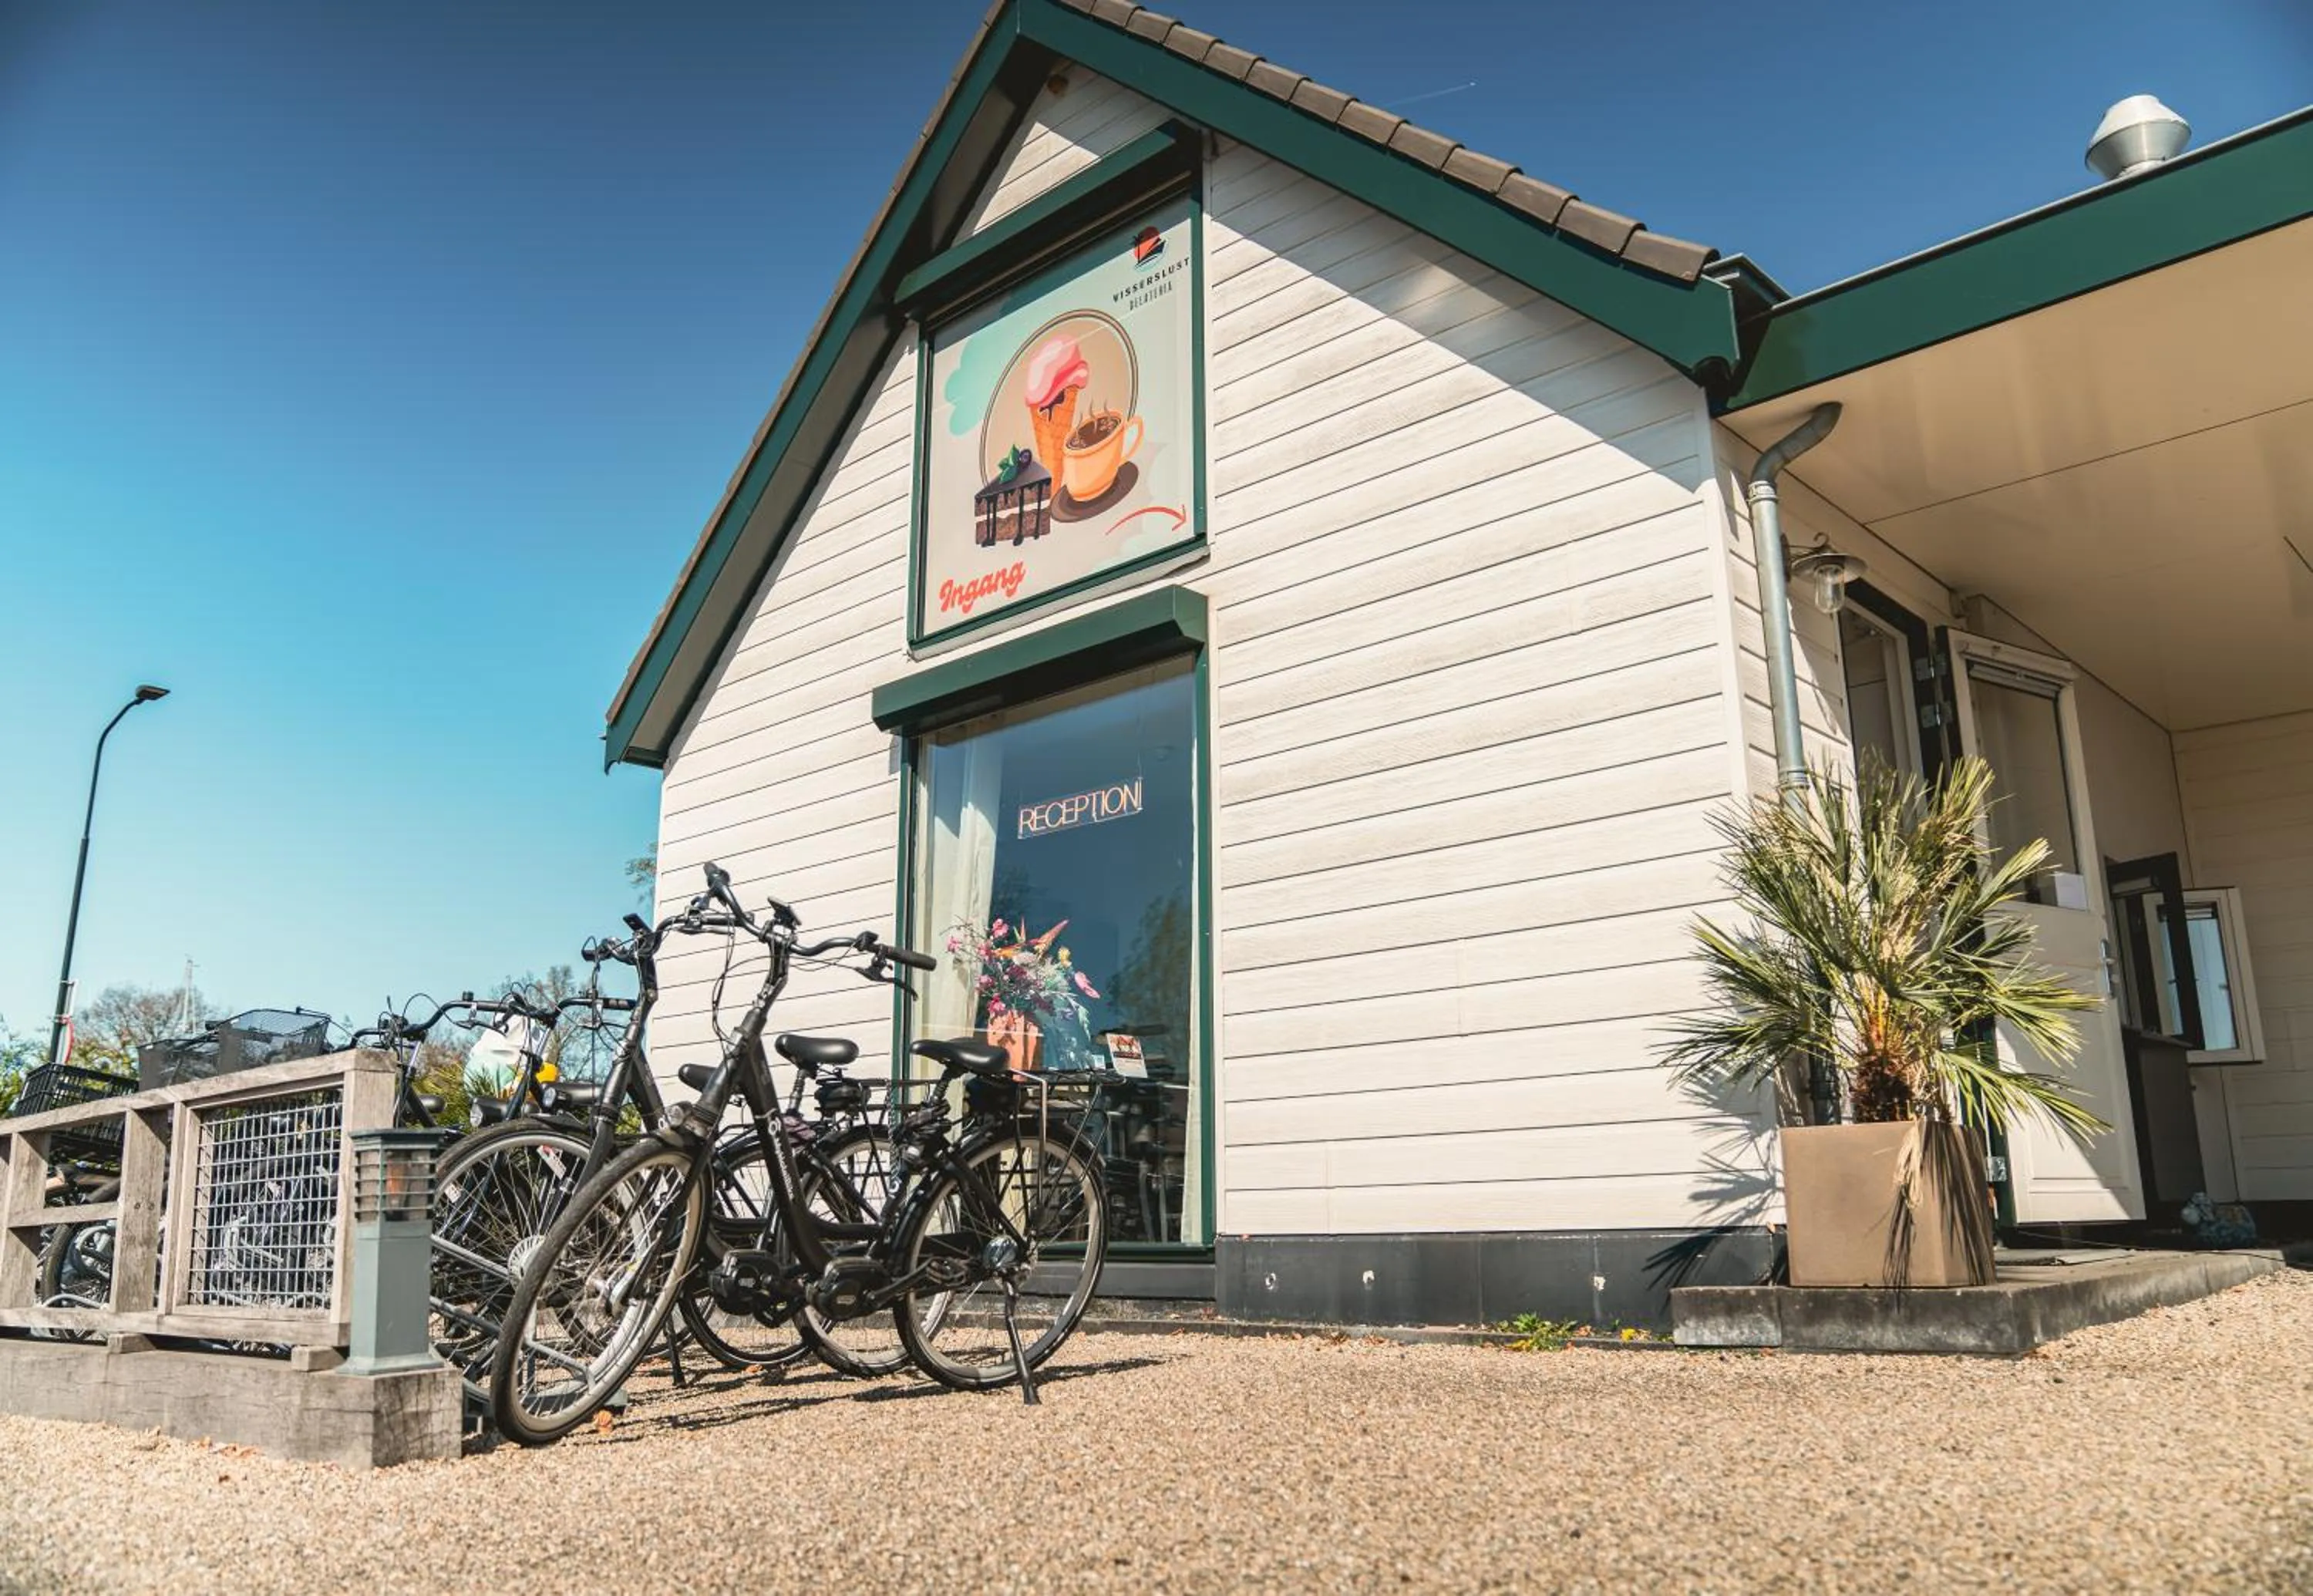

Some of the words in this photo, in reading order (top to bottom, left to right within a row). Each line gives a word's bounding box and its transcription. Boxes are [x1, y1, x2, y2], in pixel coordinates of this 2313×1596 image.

[1113, 258, 1190, 302] VISSERSLUST
[939, 561, 1026, 614] Ingang
[1018, 780, 1138, 833] RECEPTION
